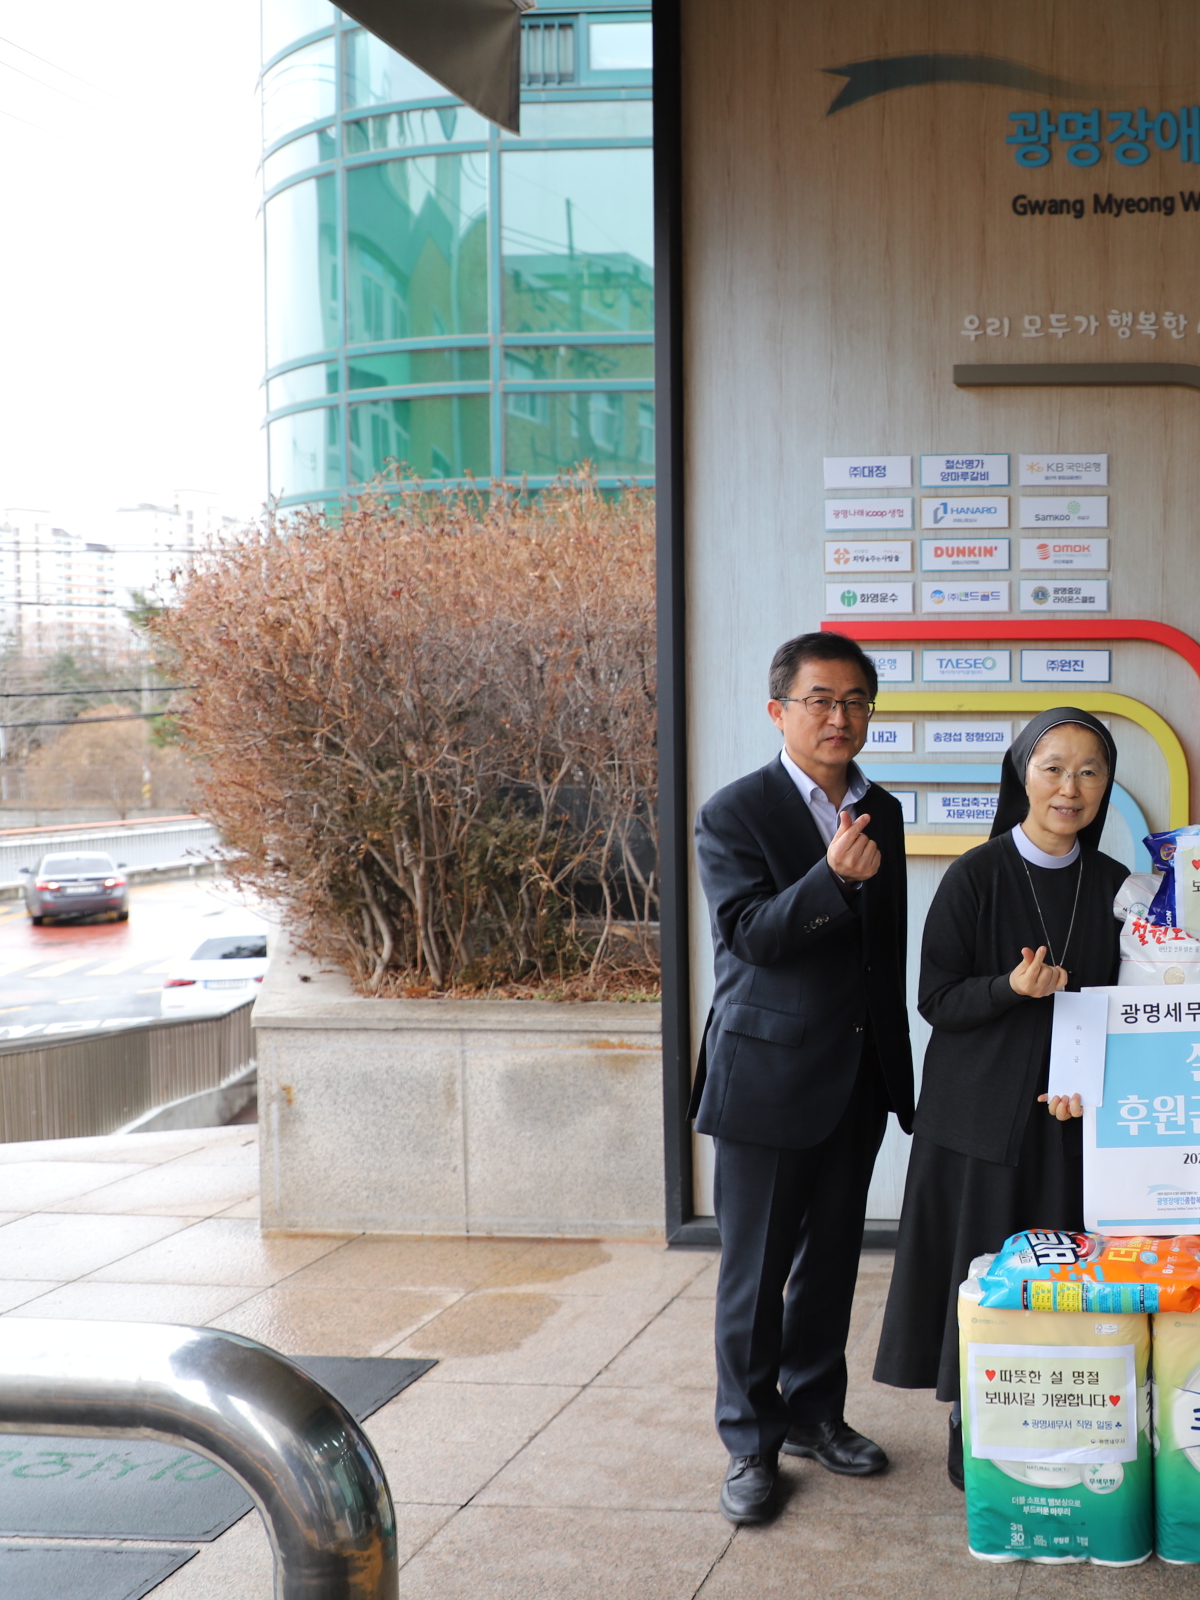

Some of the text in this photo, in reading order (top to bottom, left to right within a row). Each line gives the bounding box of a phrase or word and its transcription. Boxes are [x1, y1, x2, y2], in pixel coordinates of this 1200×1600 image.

[1012, 195, 1084, 218] Gwang
[1093, 193, 1175, 217] Myeong
[961, 314, 1011, 340] 우리
[1022, 311, 1099, 339] 모두가
[1108, 309, 1188, 341] 행복한
[945, 459, 984, 470] 철산명가
[940, 471, 989, 482] 양마루갈비
[888, 508, 904, 518] 생협
[950, 506, 997, 515] HANARO
[1034, 513, 1071, 522] Samkoo
[933, 546, 998, 558] DUNKIN'
[1053, 544, 1091, 553] OMOK
[1053, 587, 1082, 595] 광명중앙
[859, 592, 898, 603] 화영운수
[1053, 596, 1095, 604] 라이온스클럽
[936, 656, 997, 672] TAESEO
[872, 731, 897, 744] 내과
[933, 731, 1005, 743] 송경섭 정형외과
[941, 796, 999, 808] 월드컵축구단
[1164, 910, 1173, 928] LION
[1107, 1247, 1137, 1263] 더
[1000, 1369, 1100, 1386] 따뜻한 설 명절
[985, 1391, 1108, 1408] 보내시길 기원합니다.
[1031, 1419, 1113, 1430] 광명세무서 직원 일동
[1051, 1465, 1067, 1473] SOFT
[1026, 1496, 1047, 1506] 소프트
[1047, 1497, 1082, 1508] 엠보싱으로
[1022, 1505, 1072, 1517] 부드러운 마무리
[1010, 1532, 1025, 1543] 30
